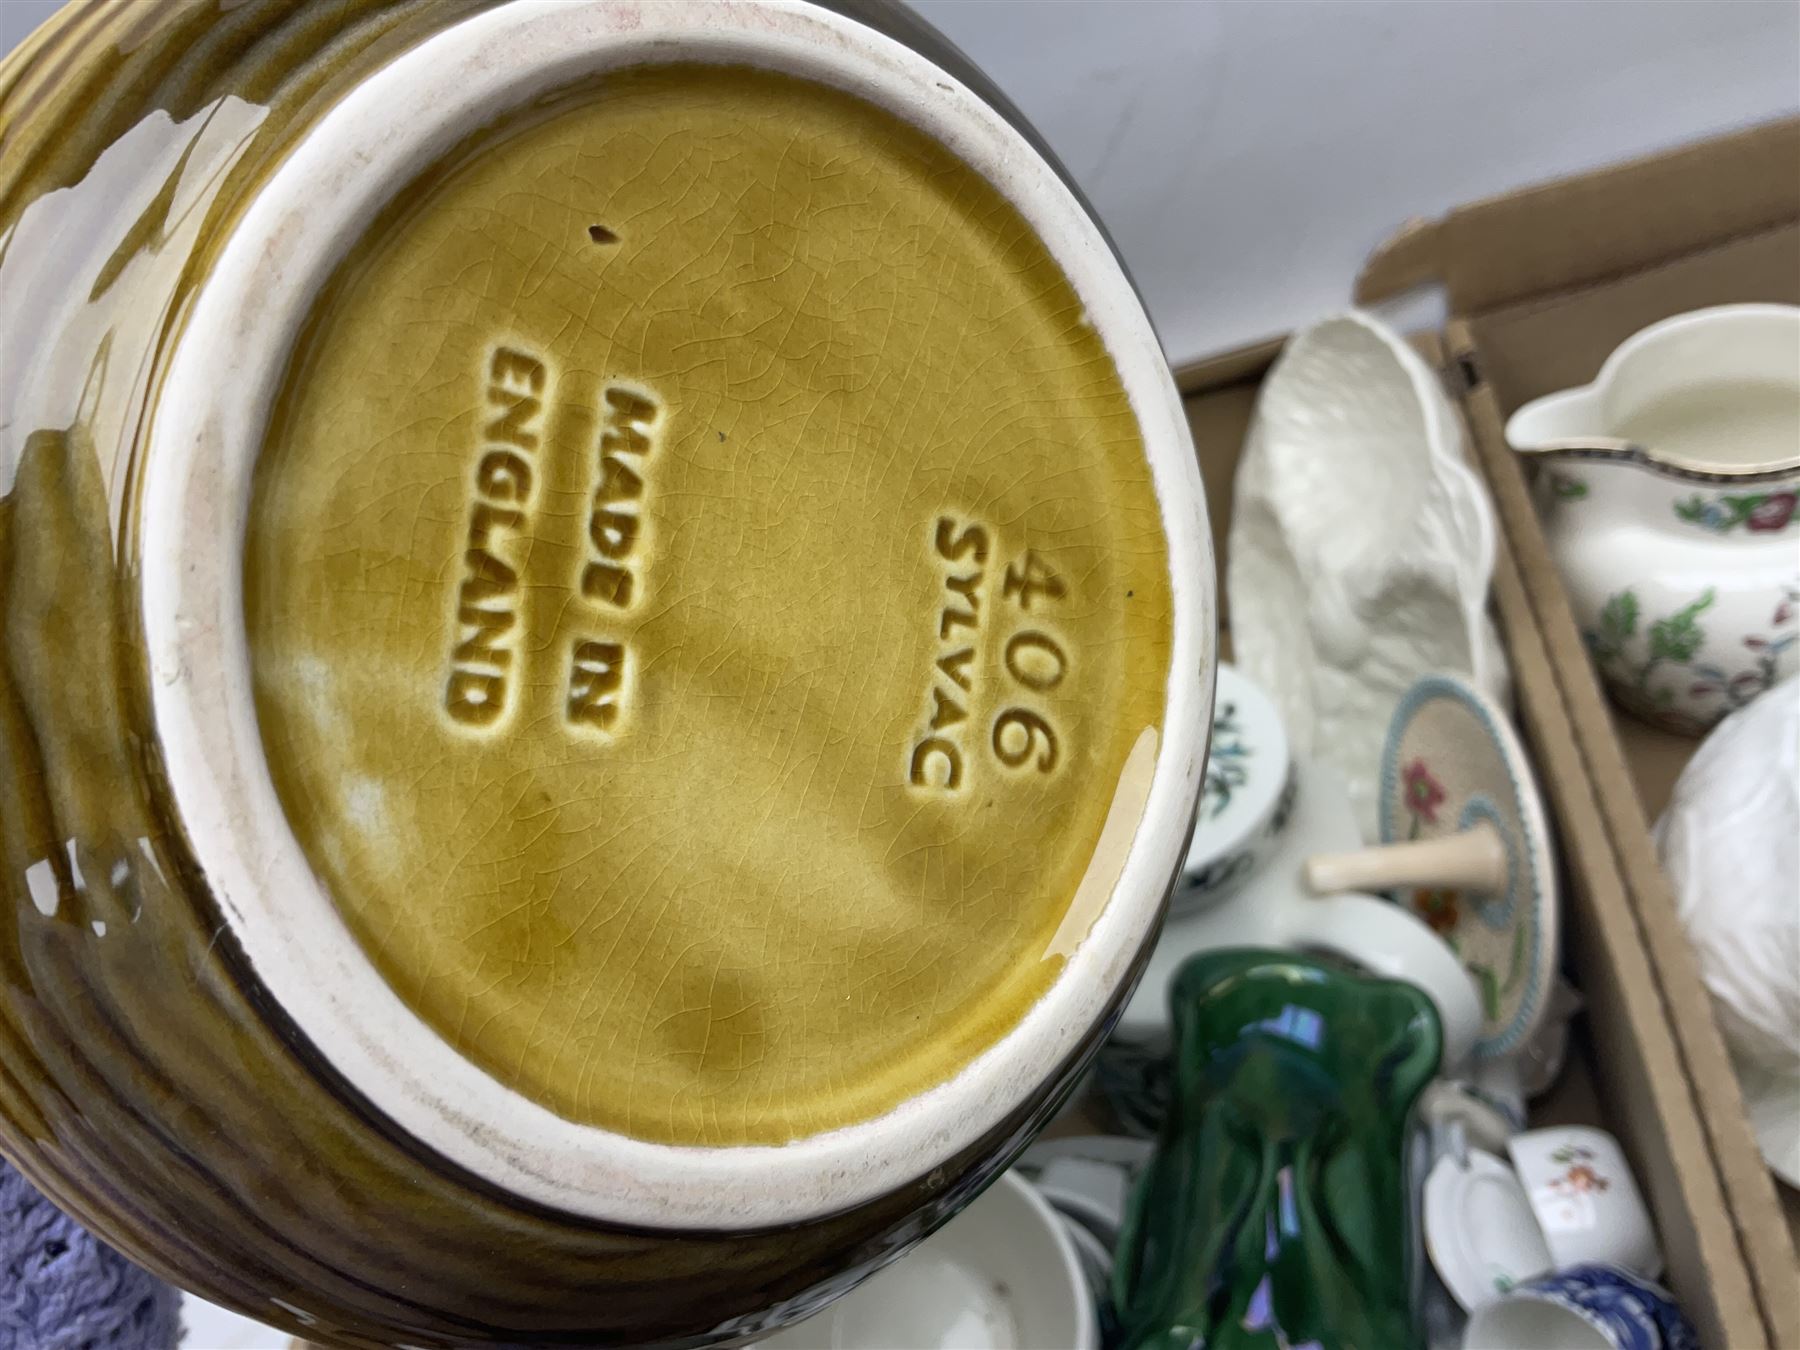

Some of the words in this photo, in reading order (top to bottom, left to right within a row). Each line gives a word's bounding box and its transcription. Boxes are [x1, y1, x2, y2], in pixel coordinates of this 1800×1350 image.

[445, 346, 547, 726] ENGLAND
[581, 386, 659, 609] MADE
[566, 640, 625, 731] IN
[910, 515, 989, 790] SYLVAC
[992, 549, 1067, 774] 406
